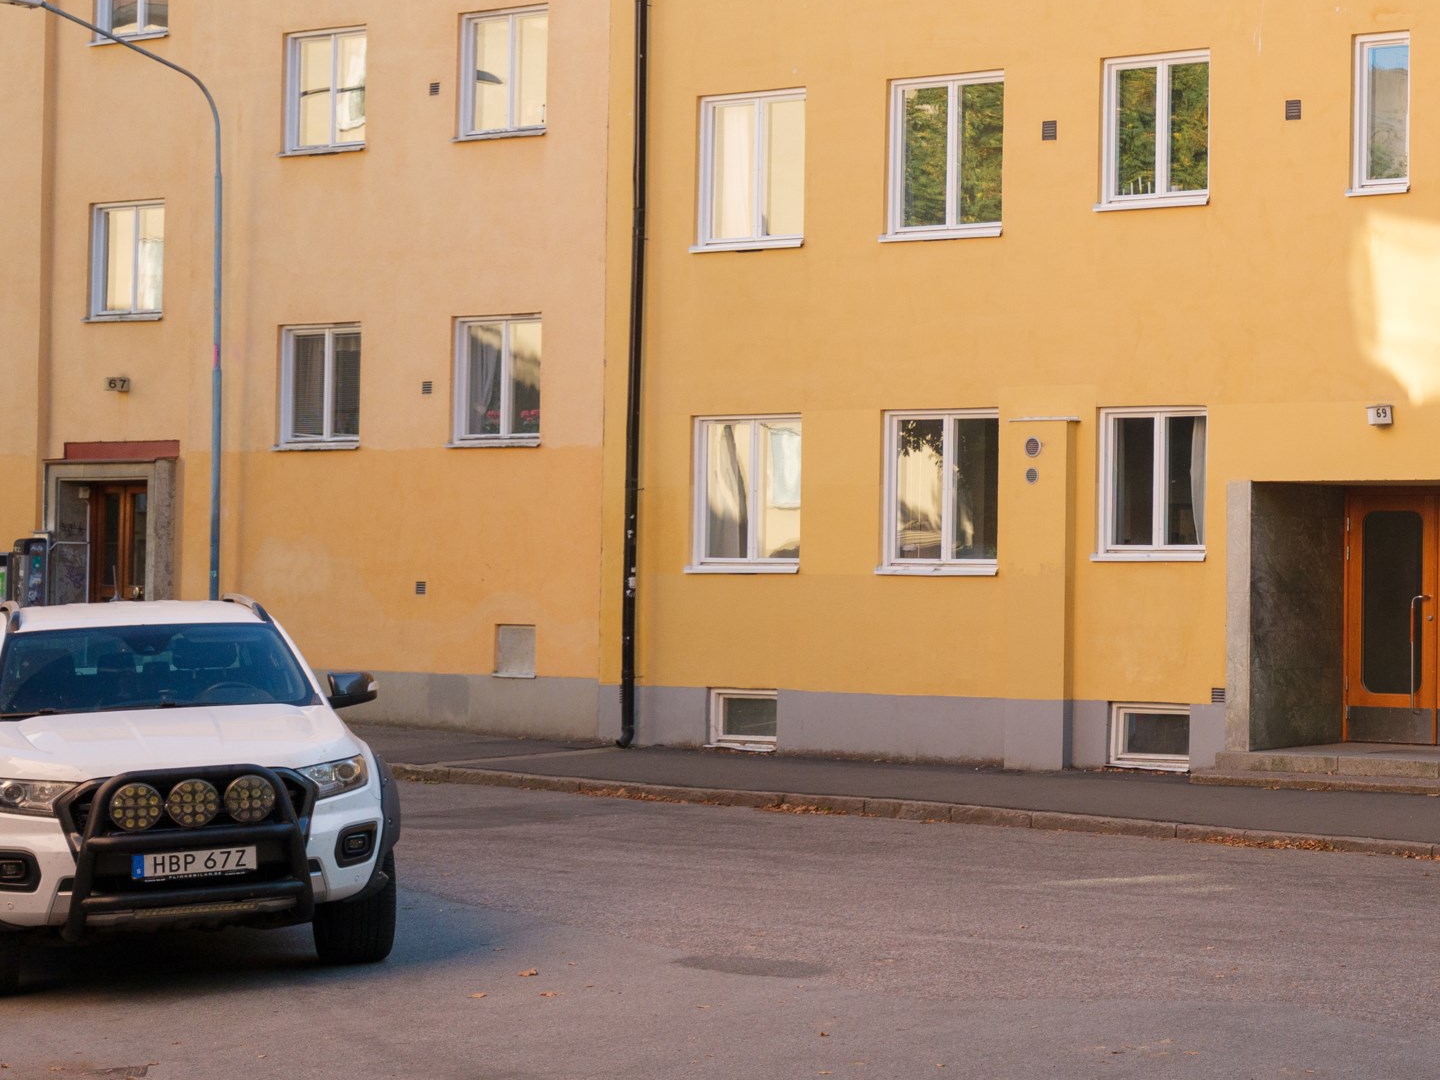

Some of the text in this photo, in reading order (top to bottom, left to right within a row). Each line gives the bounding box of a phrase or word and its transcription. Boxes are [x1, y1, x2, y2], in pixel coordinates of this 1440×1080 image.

[108, 379, 127, 389] 67
[1376, 408, 1387, 418] 69
[153, 849, 247, 874] HBP 67Z
